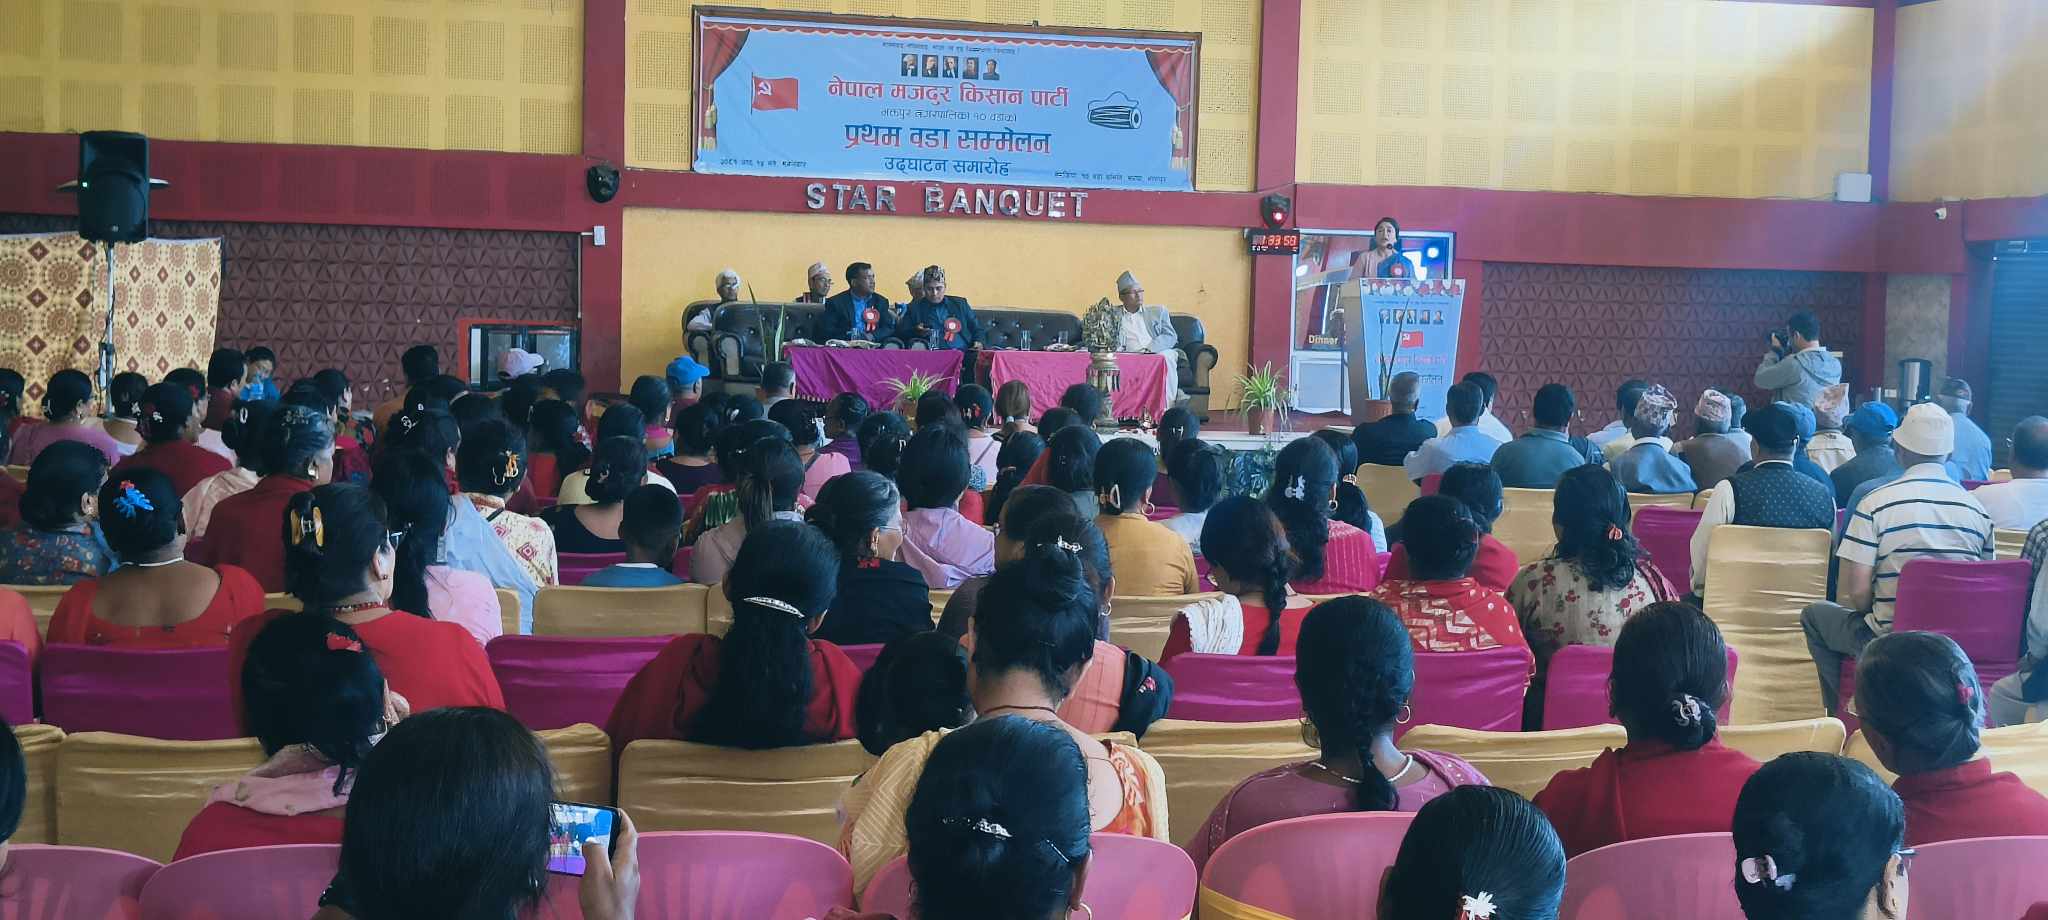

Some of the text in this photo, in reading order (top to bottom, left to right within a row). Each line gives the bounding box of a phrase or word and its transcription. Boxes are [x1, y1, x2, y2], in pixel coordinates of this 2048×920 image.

[828, 76, 1070, 107] नेपाल मजदुर किसान पार्टी
[844, 123, 1053, 154] प्रथम वडा सम्मेलन
[952, 157, 1012, 177] समारोह
[806, 183, 1088, 218] STAR BANQUET
